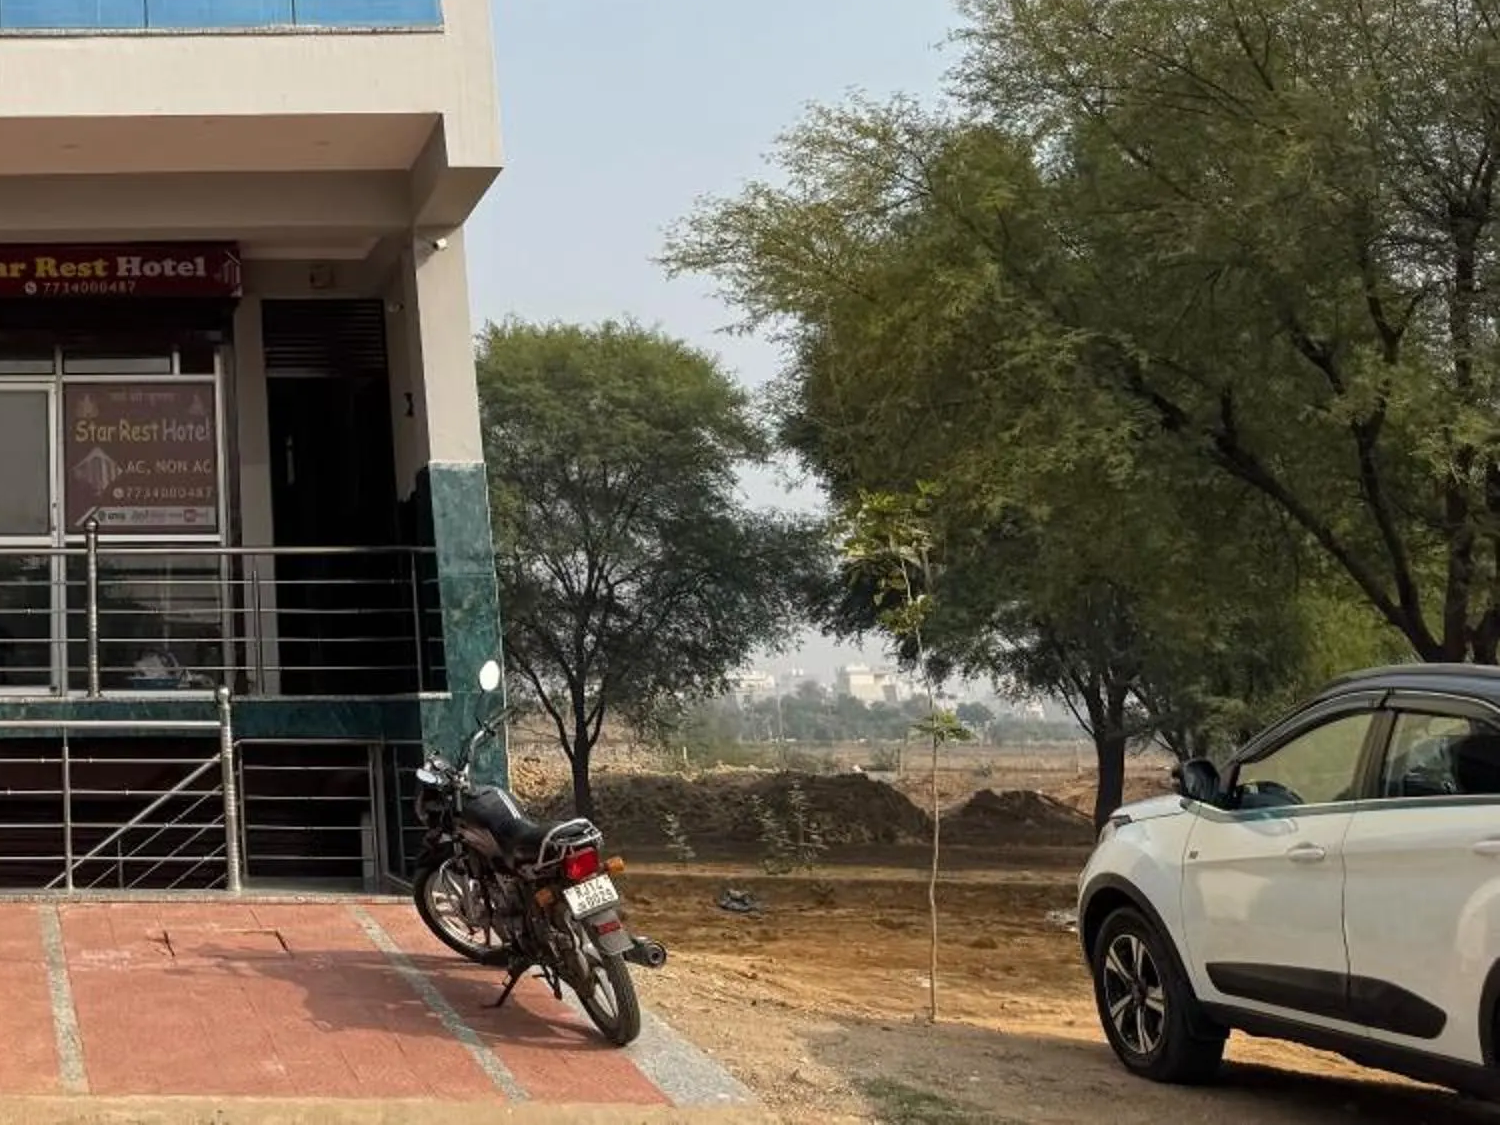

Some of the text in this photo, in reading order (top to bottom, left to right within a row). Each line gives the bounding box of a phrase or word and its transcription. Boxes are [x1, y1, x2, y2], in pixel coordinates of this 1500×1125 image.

[34, 255, 109, 278] Rest
[115, 255, 207, 277] Hotel
[75, 417, 211, 443] Star Rest Hotel
[156, 460, 189, 474] NON
[192, 459, 213, 474] AC
